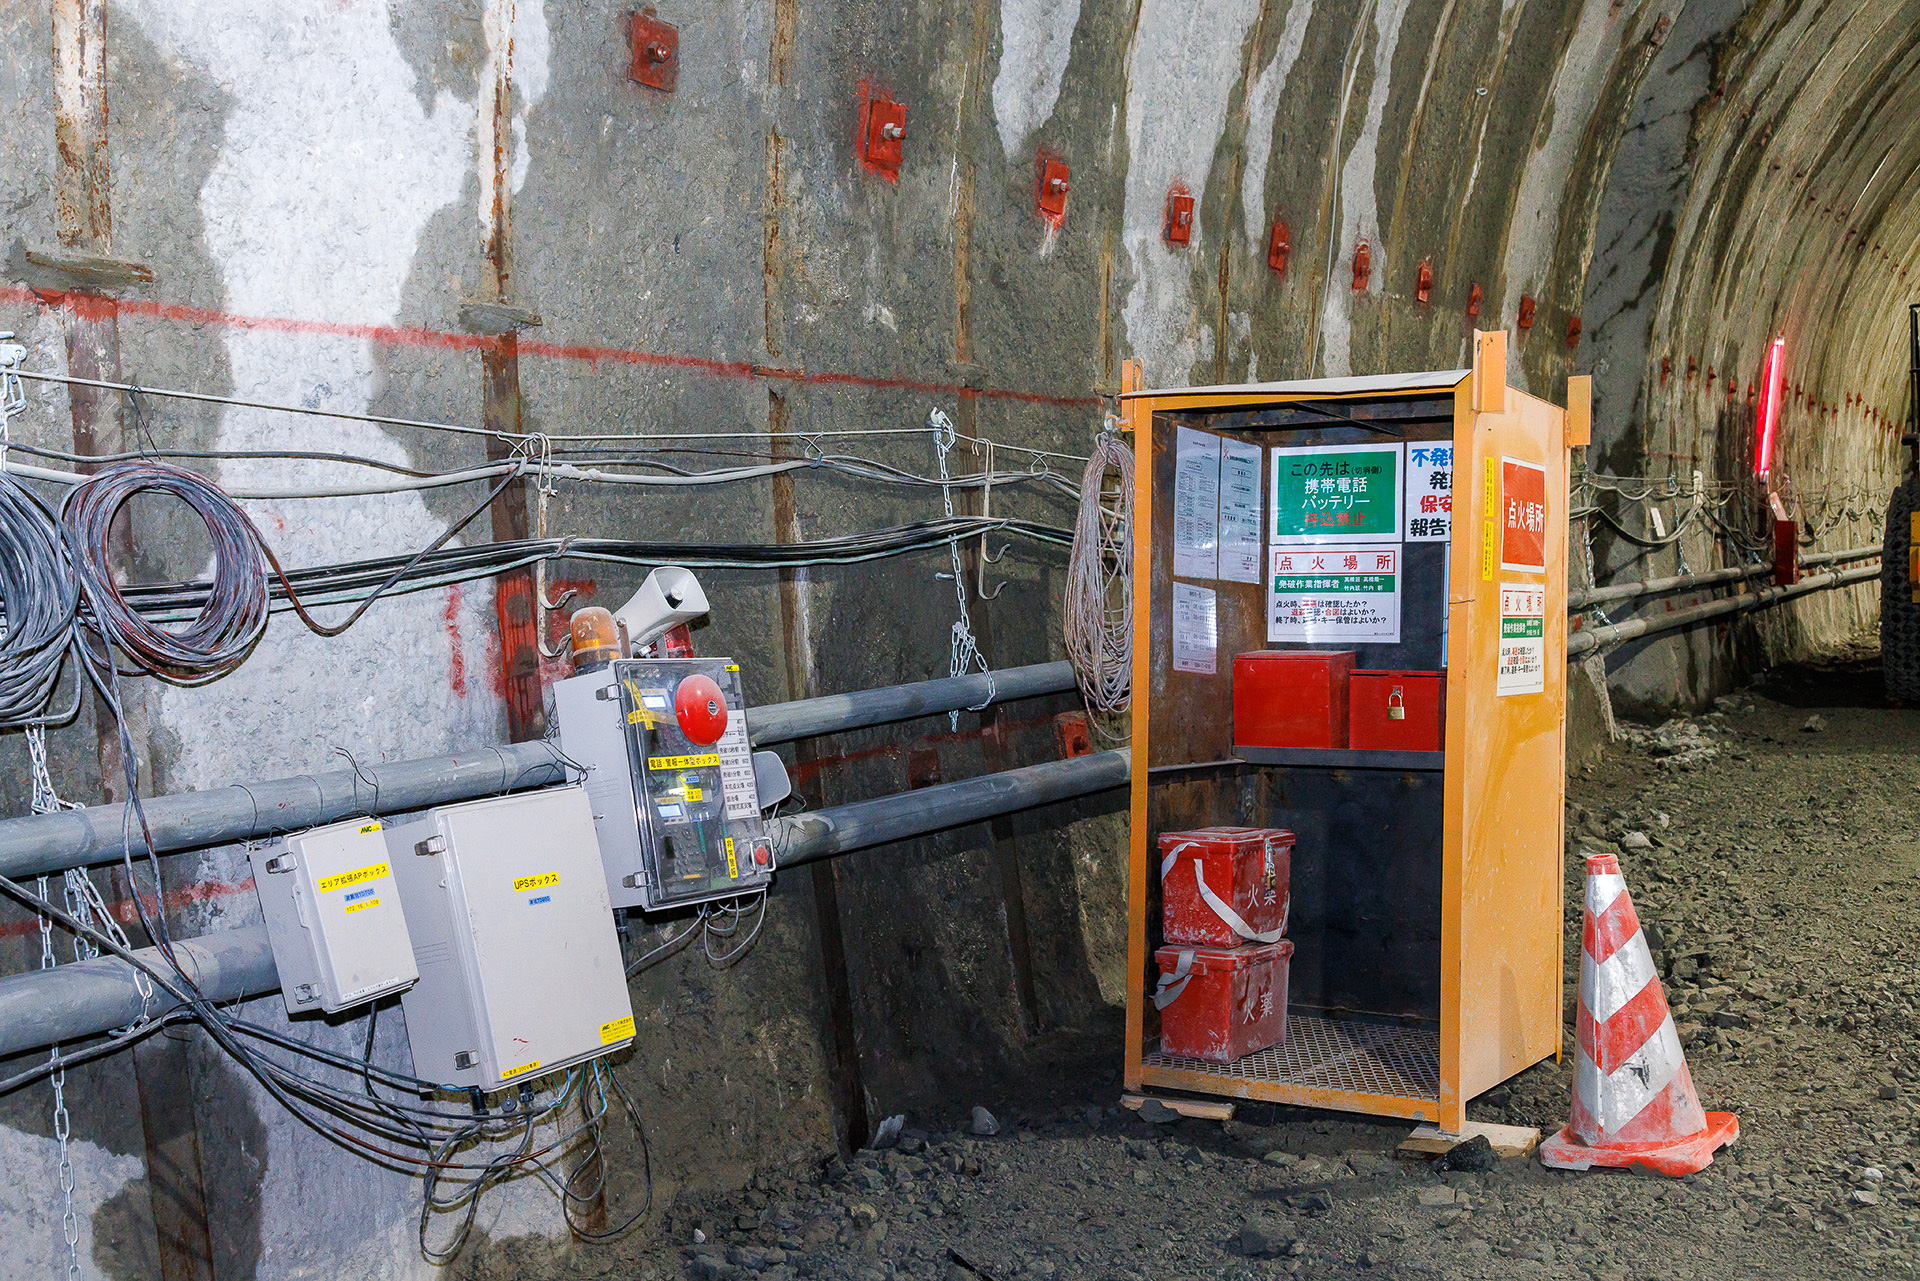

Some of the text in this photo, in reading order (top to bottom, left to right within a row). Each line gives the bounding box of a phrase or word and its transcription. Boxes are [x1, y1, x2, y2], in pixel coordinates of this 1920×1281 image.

[1304, 476, 1368, 494] 携帯電話
[1429, 471, 1453, 490] 発
[1301, 494, 1371, 510] バッテリー
[1303, 511, 1368, 528] 持込禁止
[1507, 497, 1544, 533] 点火場所
[1410, 517, 1452, 537] 報告
[1278, 579, 1341, 589] 発破作業指揮者
[321, 865, 388, 889] エリア拡張APボックス
[514, 874, 558, 890] UPSボックス
[1243, 991, 1274, 1025] 火薬
